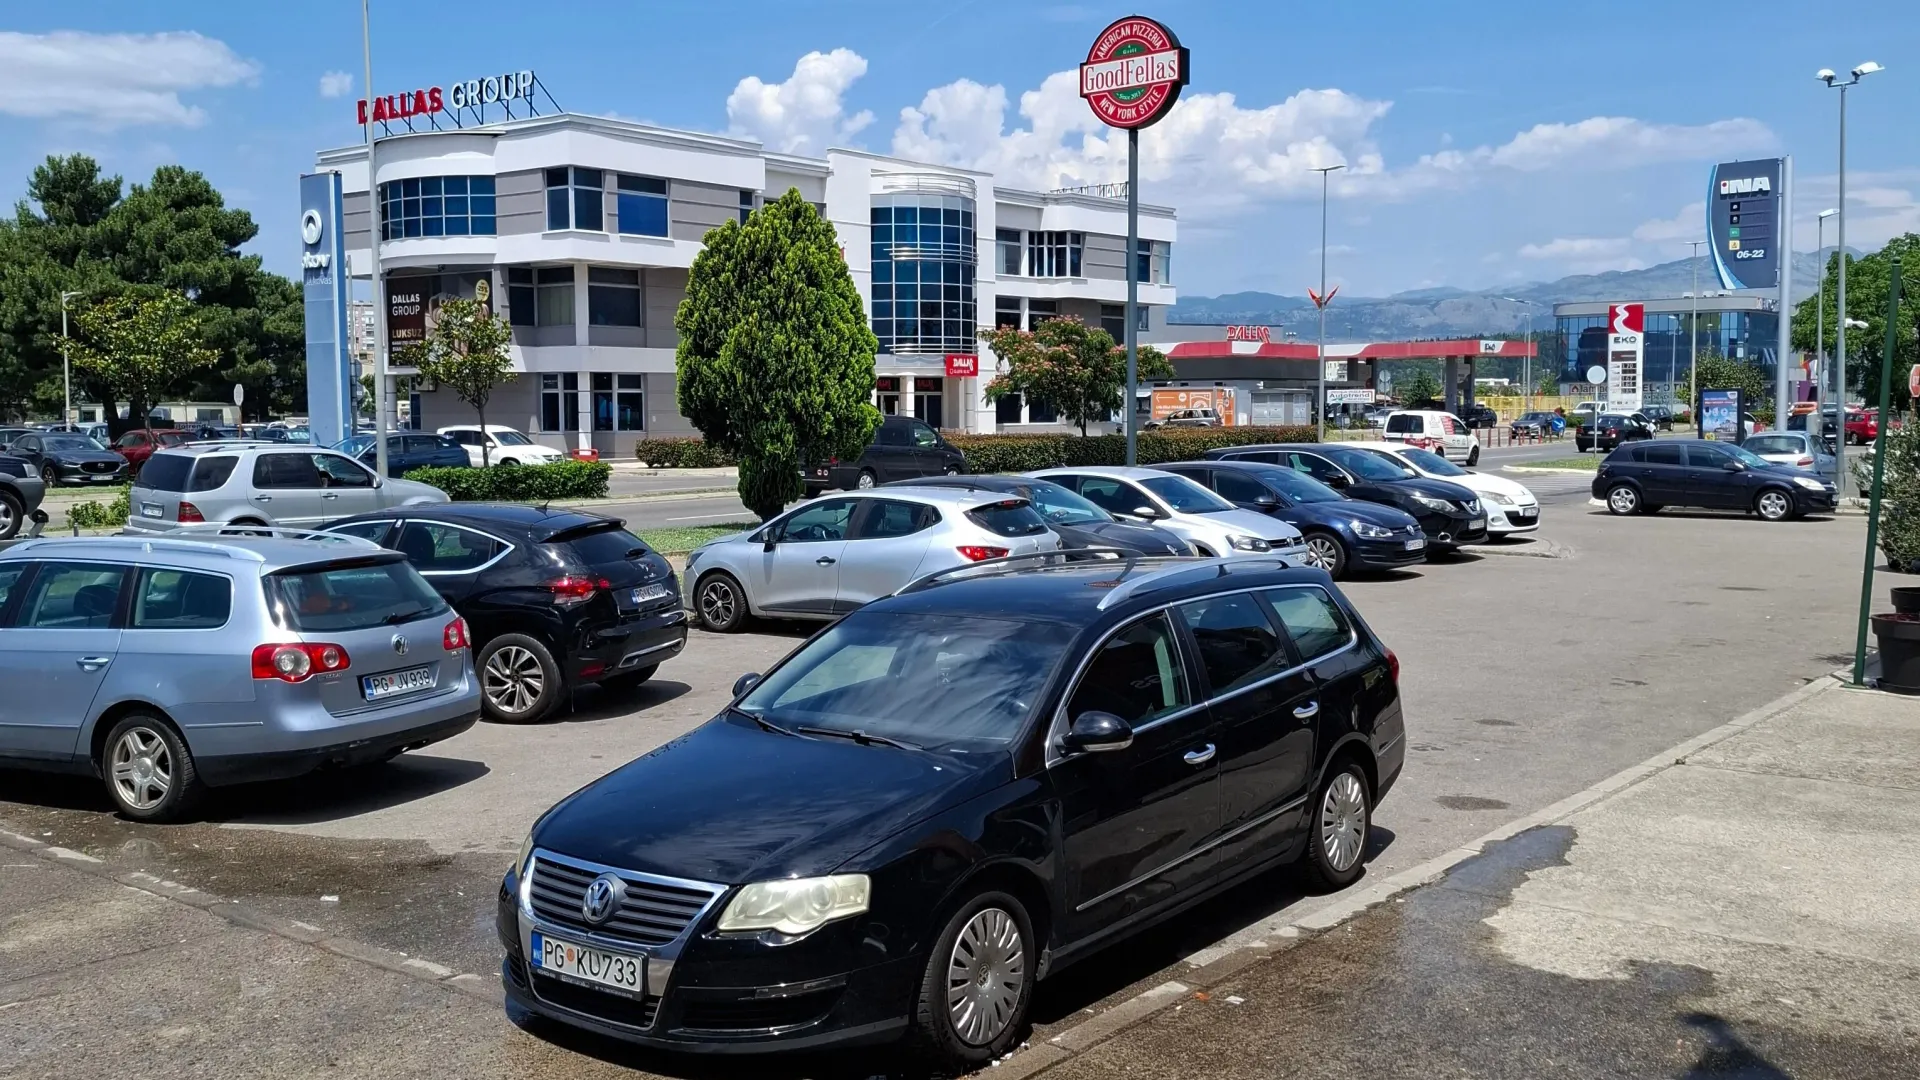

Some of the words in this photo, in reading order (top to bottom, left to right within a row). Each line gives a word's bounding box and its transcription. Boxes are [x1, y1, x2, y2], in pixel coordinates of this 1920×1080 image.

[1097, 25, 1131, 58] AMERICAN
[1132, 24, 1164, 49] PIZZERIA
[1085, 56, 1176, 91] GoodFellas
[357, 86, 443, 124] DALLAS
[451, 70, 532, 109] GROUP
[1099, 97, 1116, 116] NEW
[1116, 107, 1138, 120] YORK
[1139, 89, 1162, 115] STYLE
[1736, 249, 1765, 259] 06-22
[392, 294, 420, 304] DALLAS
[392, 305, 421, 316] GROUP
[392, 328, 422, 338] LUKSUZ
[1613, 336, 1637, 344] EKO
[372, 677, 389, 693] PG
[397, 669, 432, 689] JV939
[544, 940, 565, 969] PG
[576, 949, 637, 987] KU733
